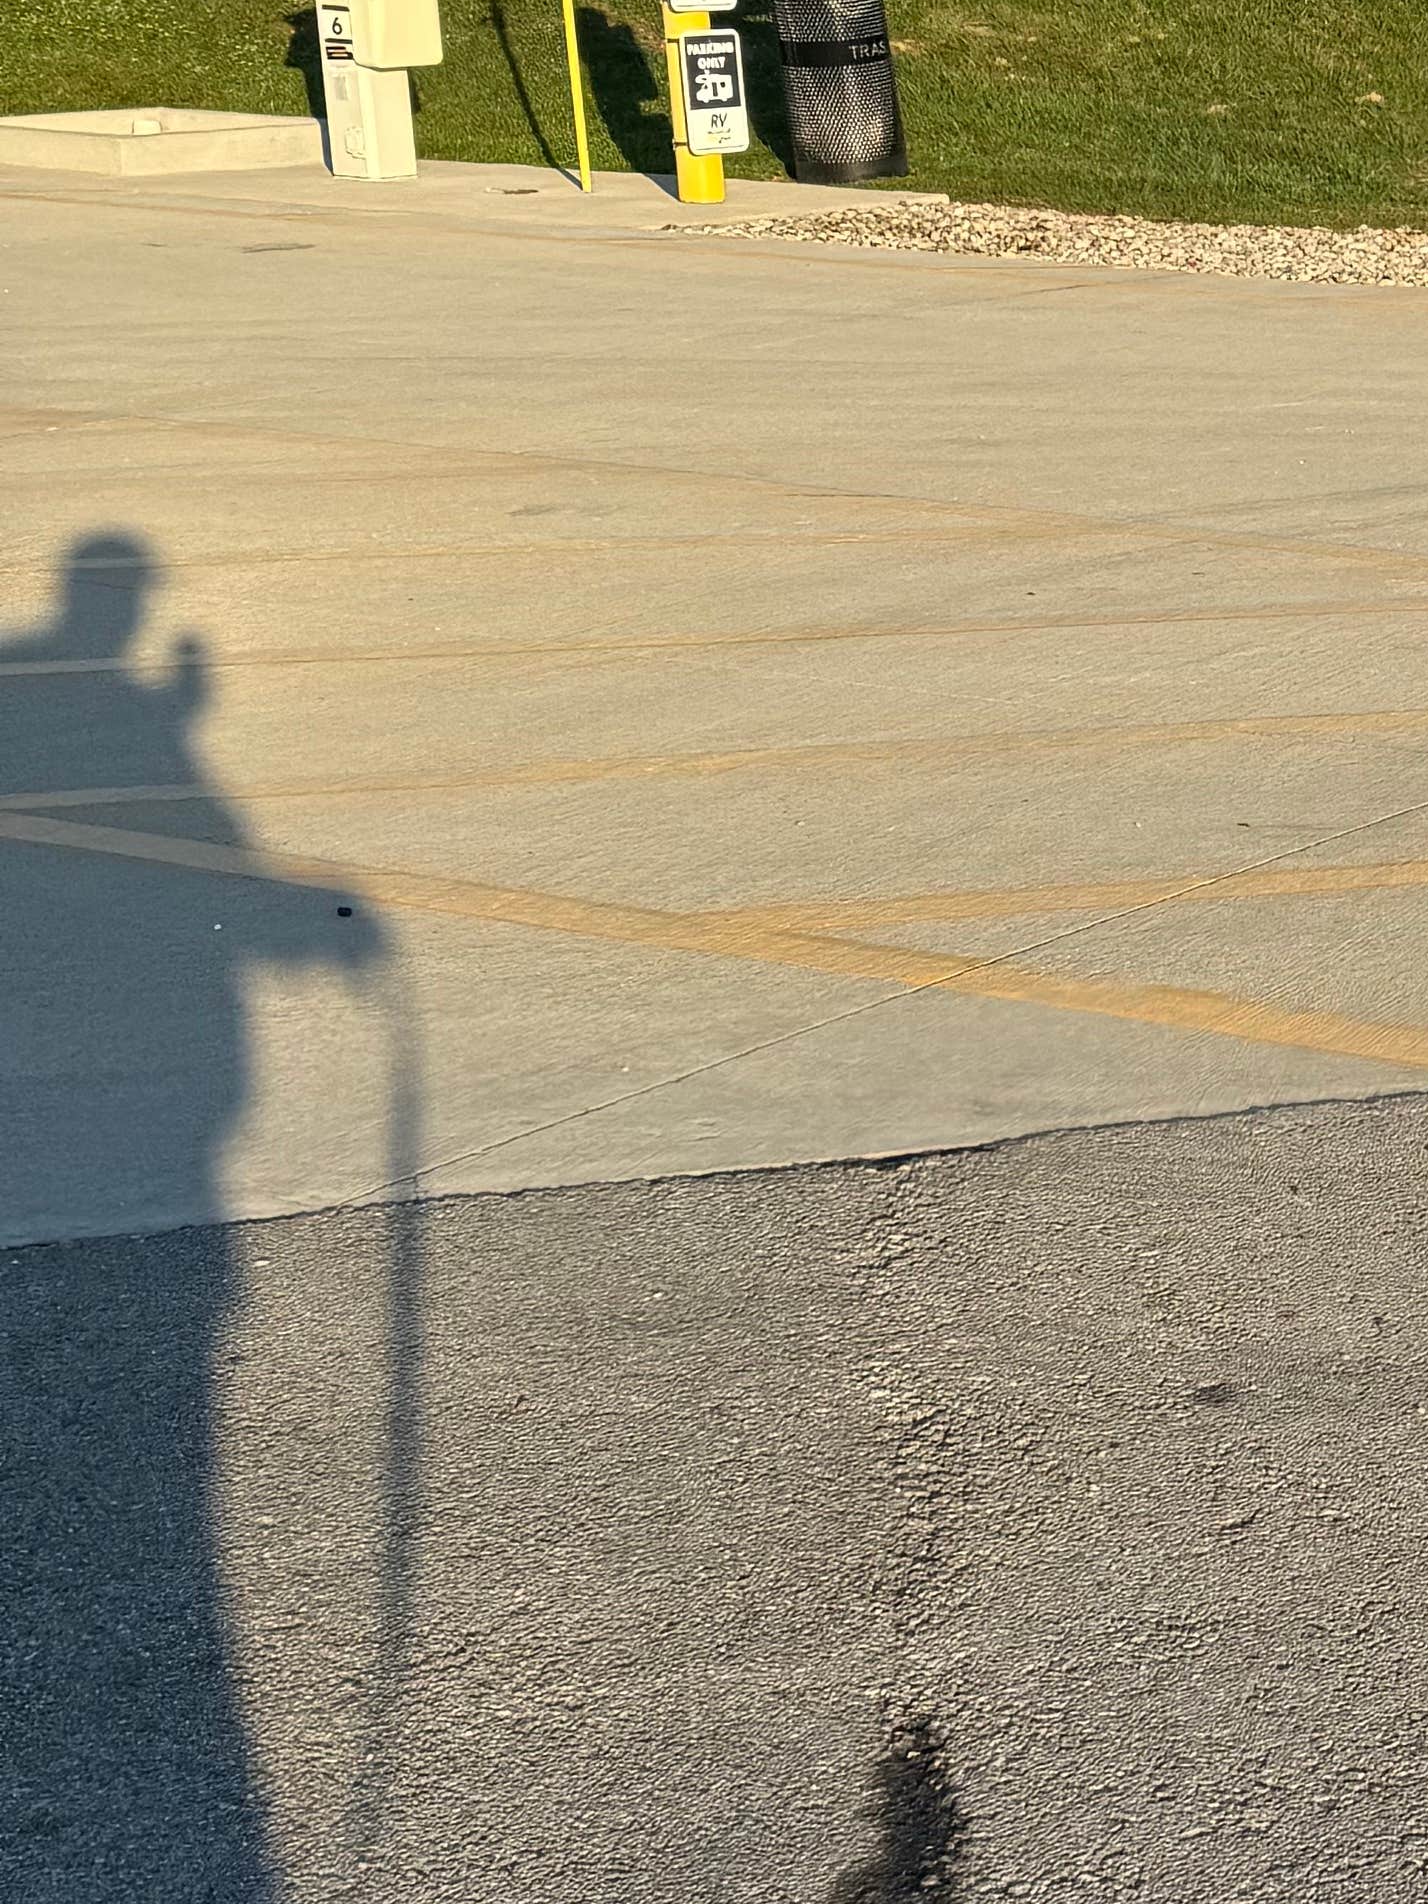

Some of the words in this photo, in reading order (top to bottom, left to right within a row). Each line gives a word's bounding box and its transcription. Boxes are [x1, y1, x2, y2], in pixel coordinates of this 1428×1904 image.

[331, 16, 343, 36] 6
[686, 41, 734, 56] PARKING
[697, 56, 726, 70] ONLY
[711, 112, 728, 129] RV
